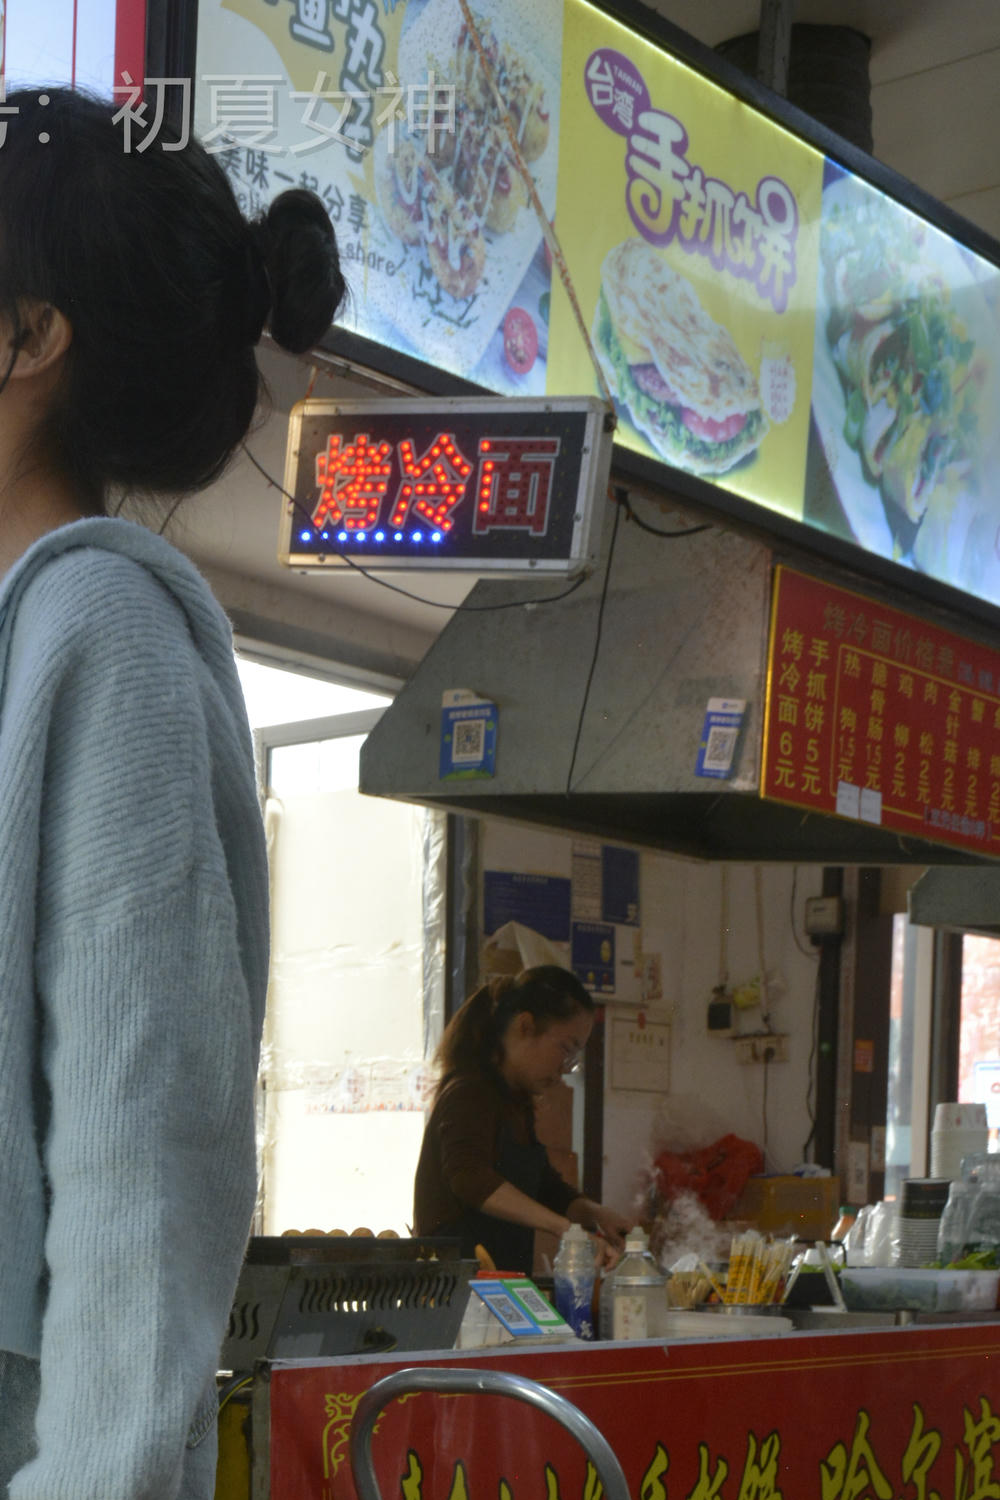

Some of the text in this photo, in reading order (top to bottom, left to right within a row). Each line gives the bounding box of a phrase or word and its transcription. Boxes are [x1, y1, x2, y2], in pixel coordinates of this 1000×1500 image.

[627, 109, 795, 308] 手抓饼
[312, 433, 561, 537] 烤冷面
